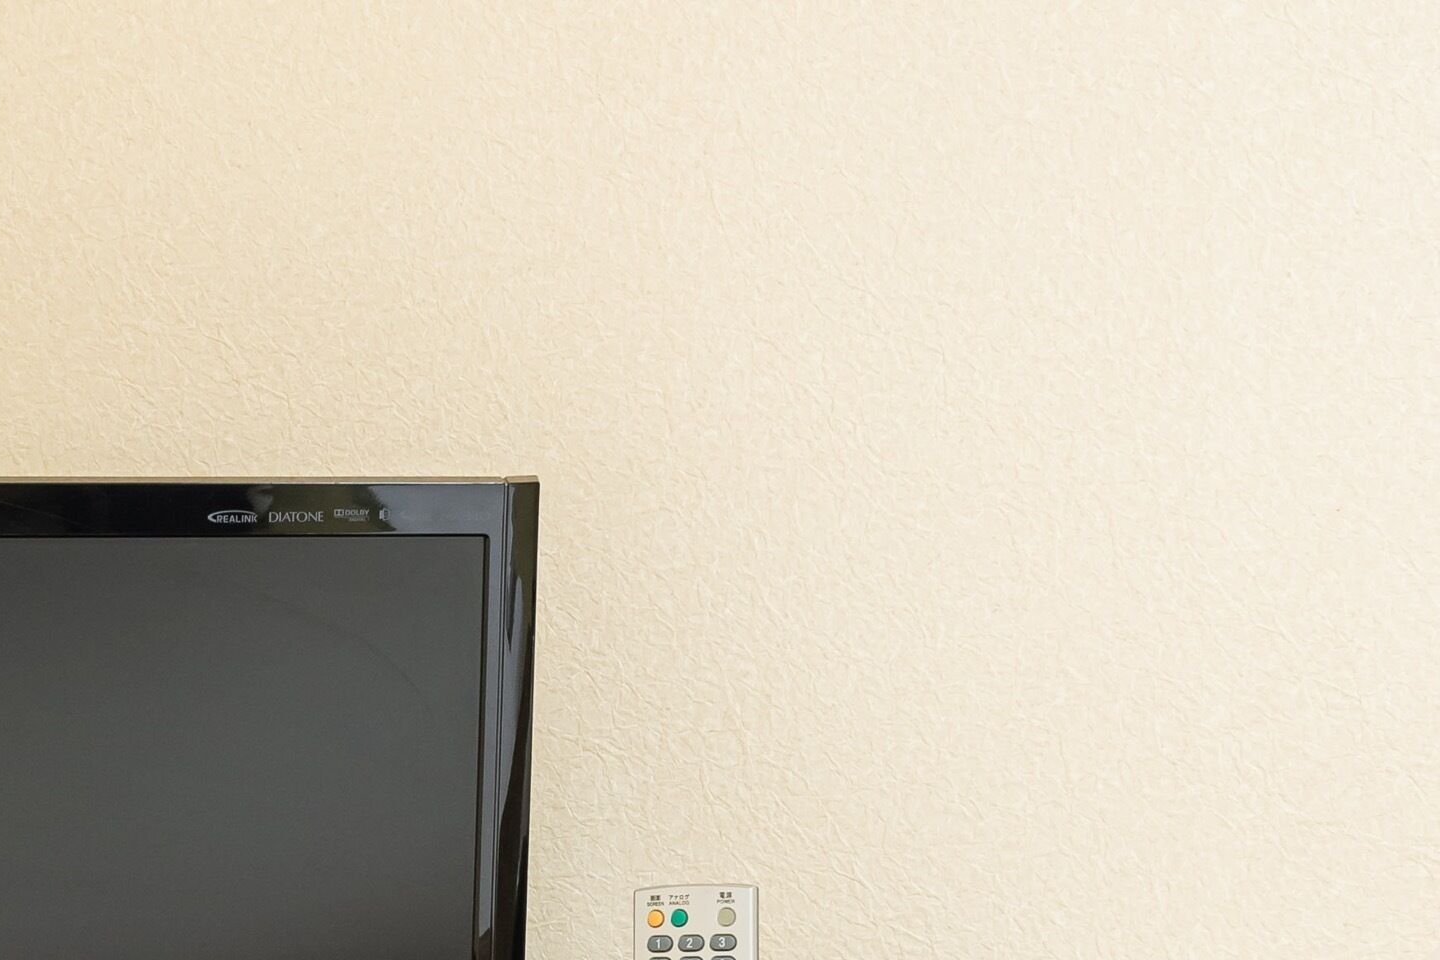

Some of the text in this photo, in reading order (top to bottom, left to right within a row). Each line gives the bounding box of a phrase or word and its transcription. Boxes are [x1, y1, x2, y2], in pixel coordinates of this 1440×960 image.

[216, 512, 258, 524] REALINK
[268, 511, 325, 523] DIATONE
[656, 938, 661, 949] 1
[686, 937, 693, 949] 2
[718, 936, 726, 948] 3
